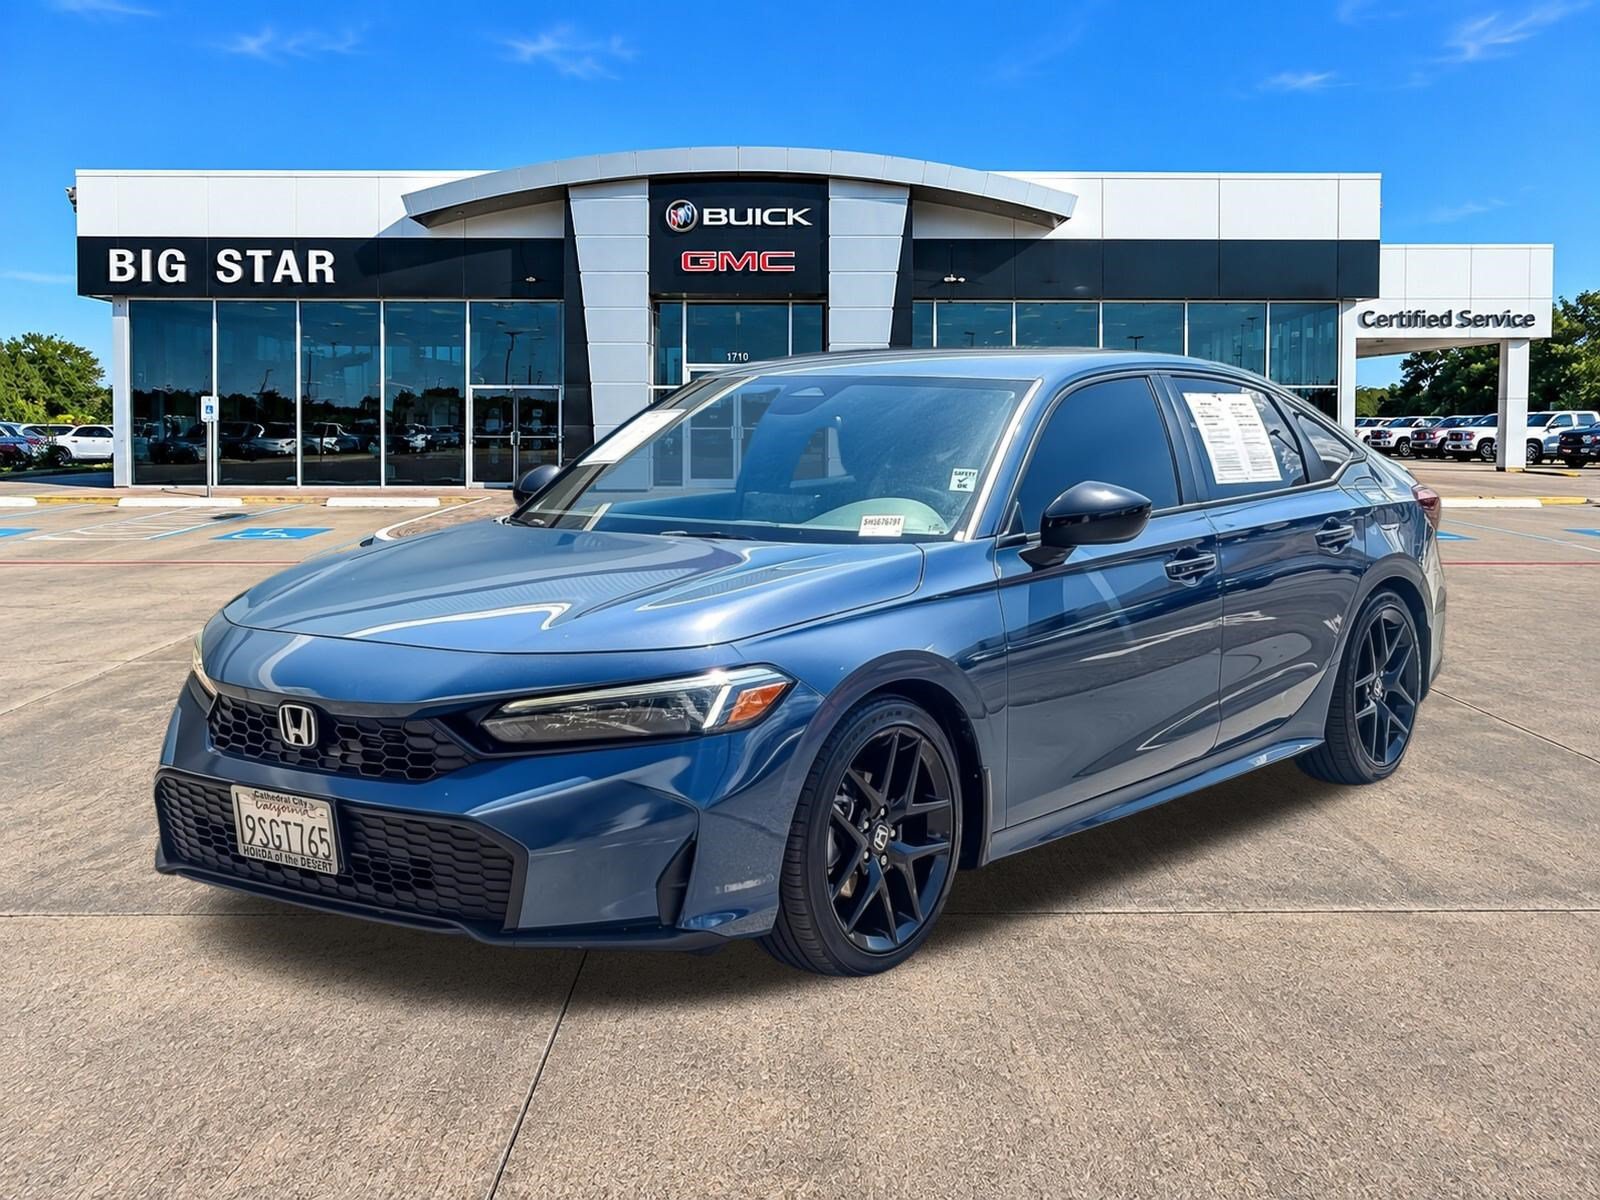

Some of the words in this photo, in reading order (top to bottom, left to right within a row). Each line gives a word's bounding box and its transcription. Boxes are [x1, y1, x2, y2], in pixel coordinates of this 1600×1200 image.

[702, 207, 814, 226] BUICK
[108, 248, 187, 283] BIG
[216, 248, 336, 284] STAR
[681, 250, 796, 272] GMC
[1359, 309, 1453, 328] Certified
[1456, 309, 1536, 328] Service
[727, 352, 749, 361] 1710
[254, 790, 291, 804] Cathedral
[292, 797, 308, 808] City
[255, 800, 316, 819] California
[245, 814, 332, 859] 9SGT765
[243, 845, 273, 861] HONDA
[274, 852, 283, 861] of
[284, 853, 299, 866] the
[300, 856, 333, 873] DESERT
